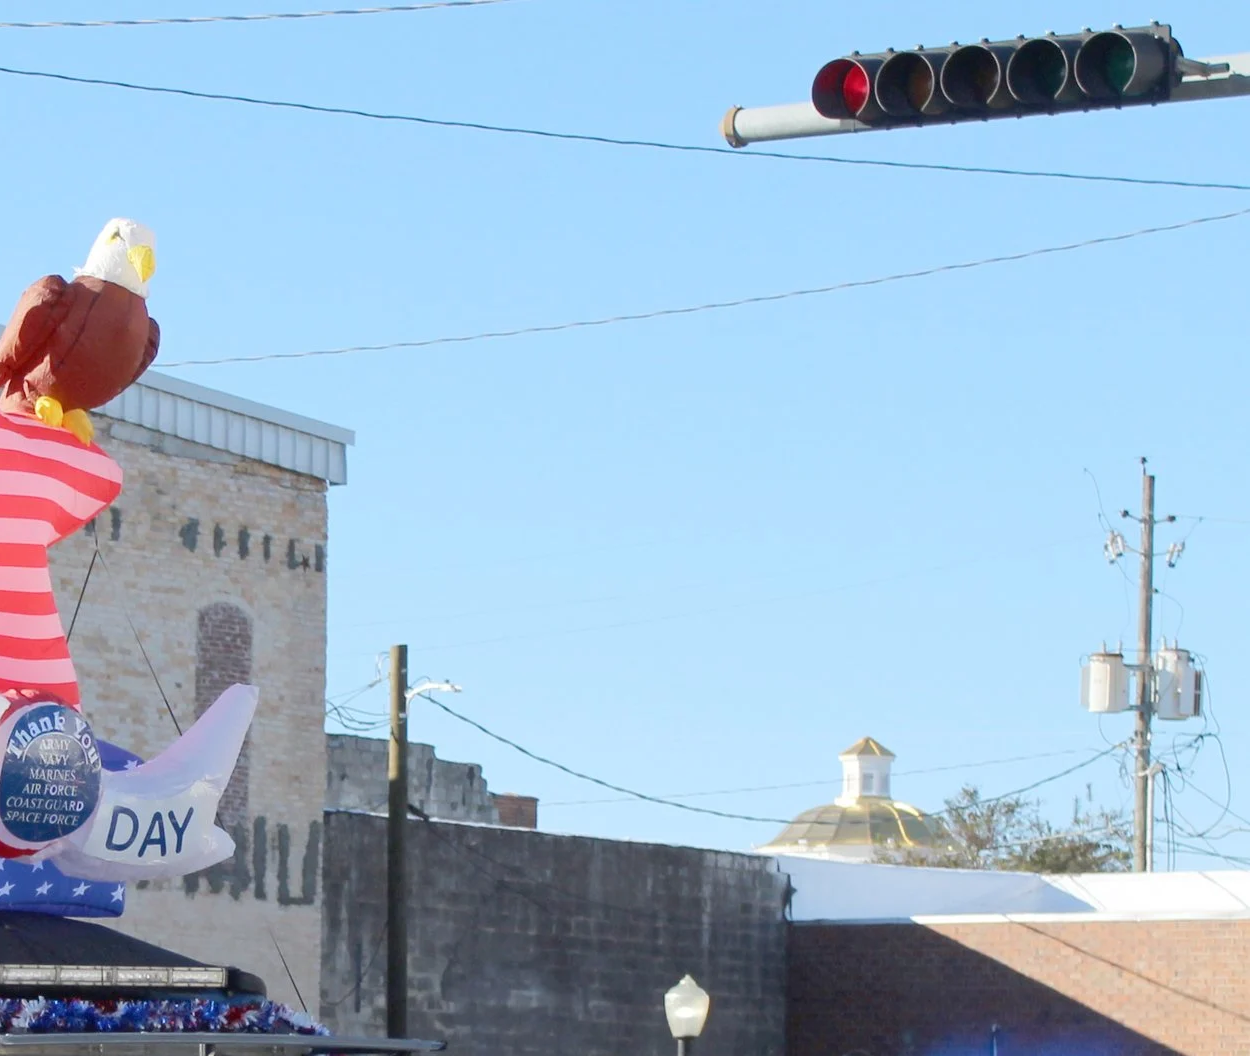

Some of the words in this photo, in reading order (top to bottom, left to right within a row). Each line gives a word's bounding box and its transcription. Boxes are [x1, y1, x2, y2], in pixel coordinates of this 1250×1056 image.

[6, 711, 66, 760] Thank
[74, 717, 99, 765] You
[39, 739, 70, 751] ARMY
[39, 754, 69, 766] NAVY
[29, 767, 76, 781] MARINES
[21, 783, 43, 796] AIR
[44, 784, 79, 798] FORCE
[6, 796, 44, 810] COAST
[45, 799, 85, 813] GUARD
[4, 811, 42, 824] SPACE
[43, 813, 81, 827] FORCE
[105, 805, 194, 858] DAY
